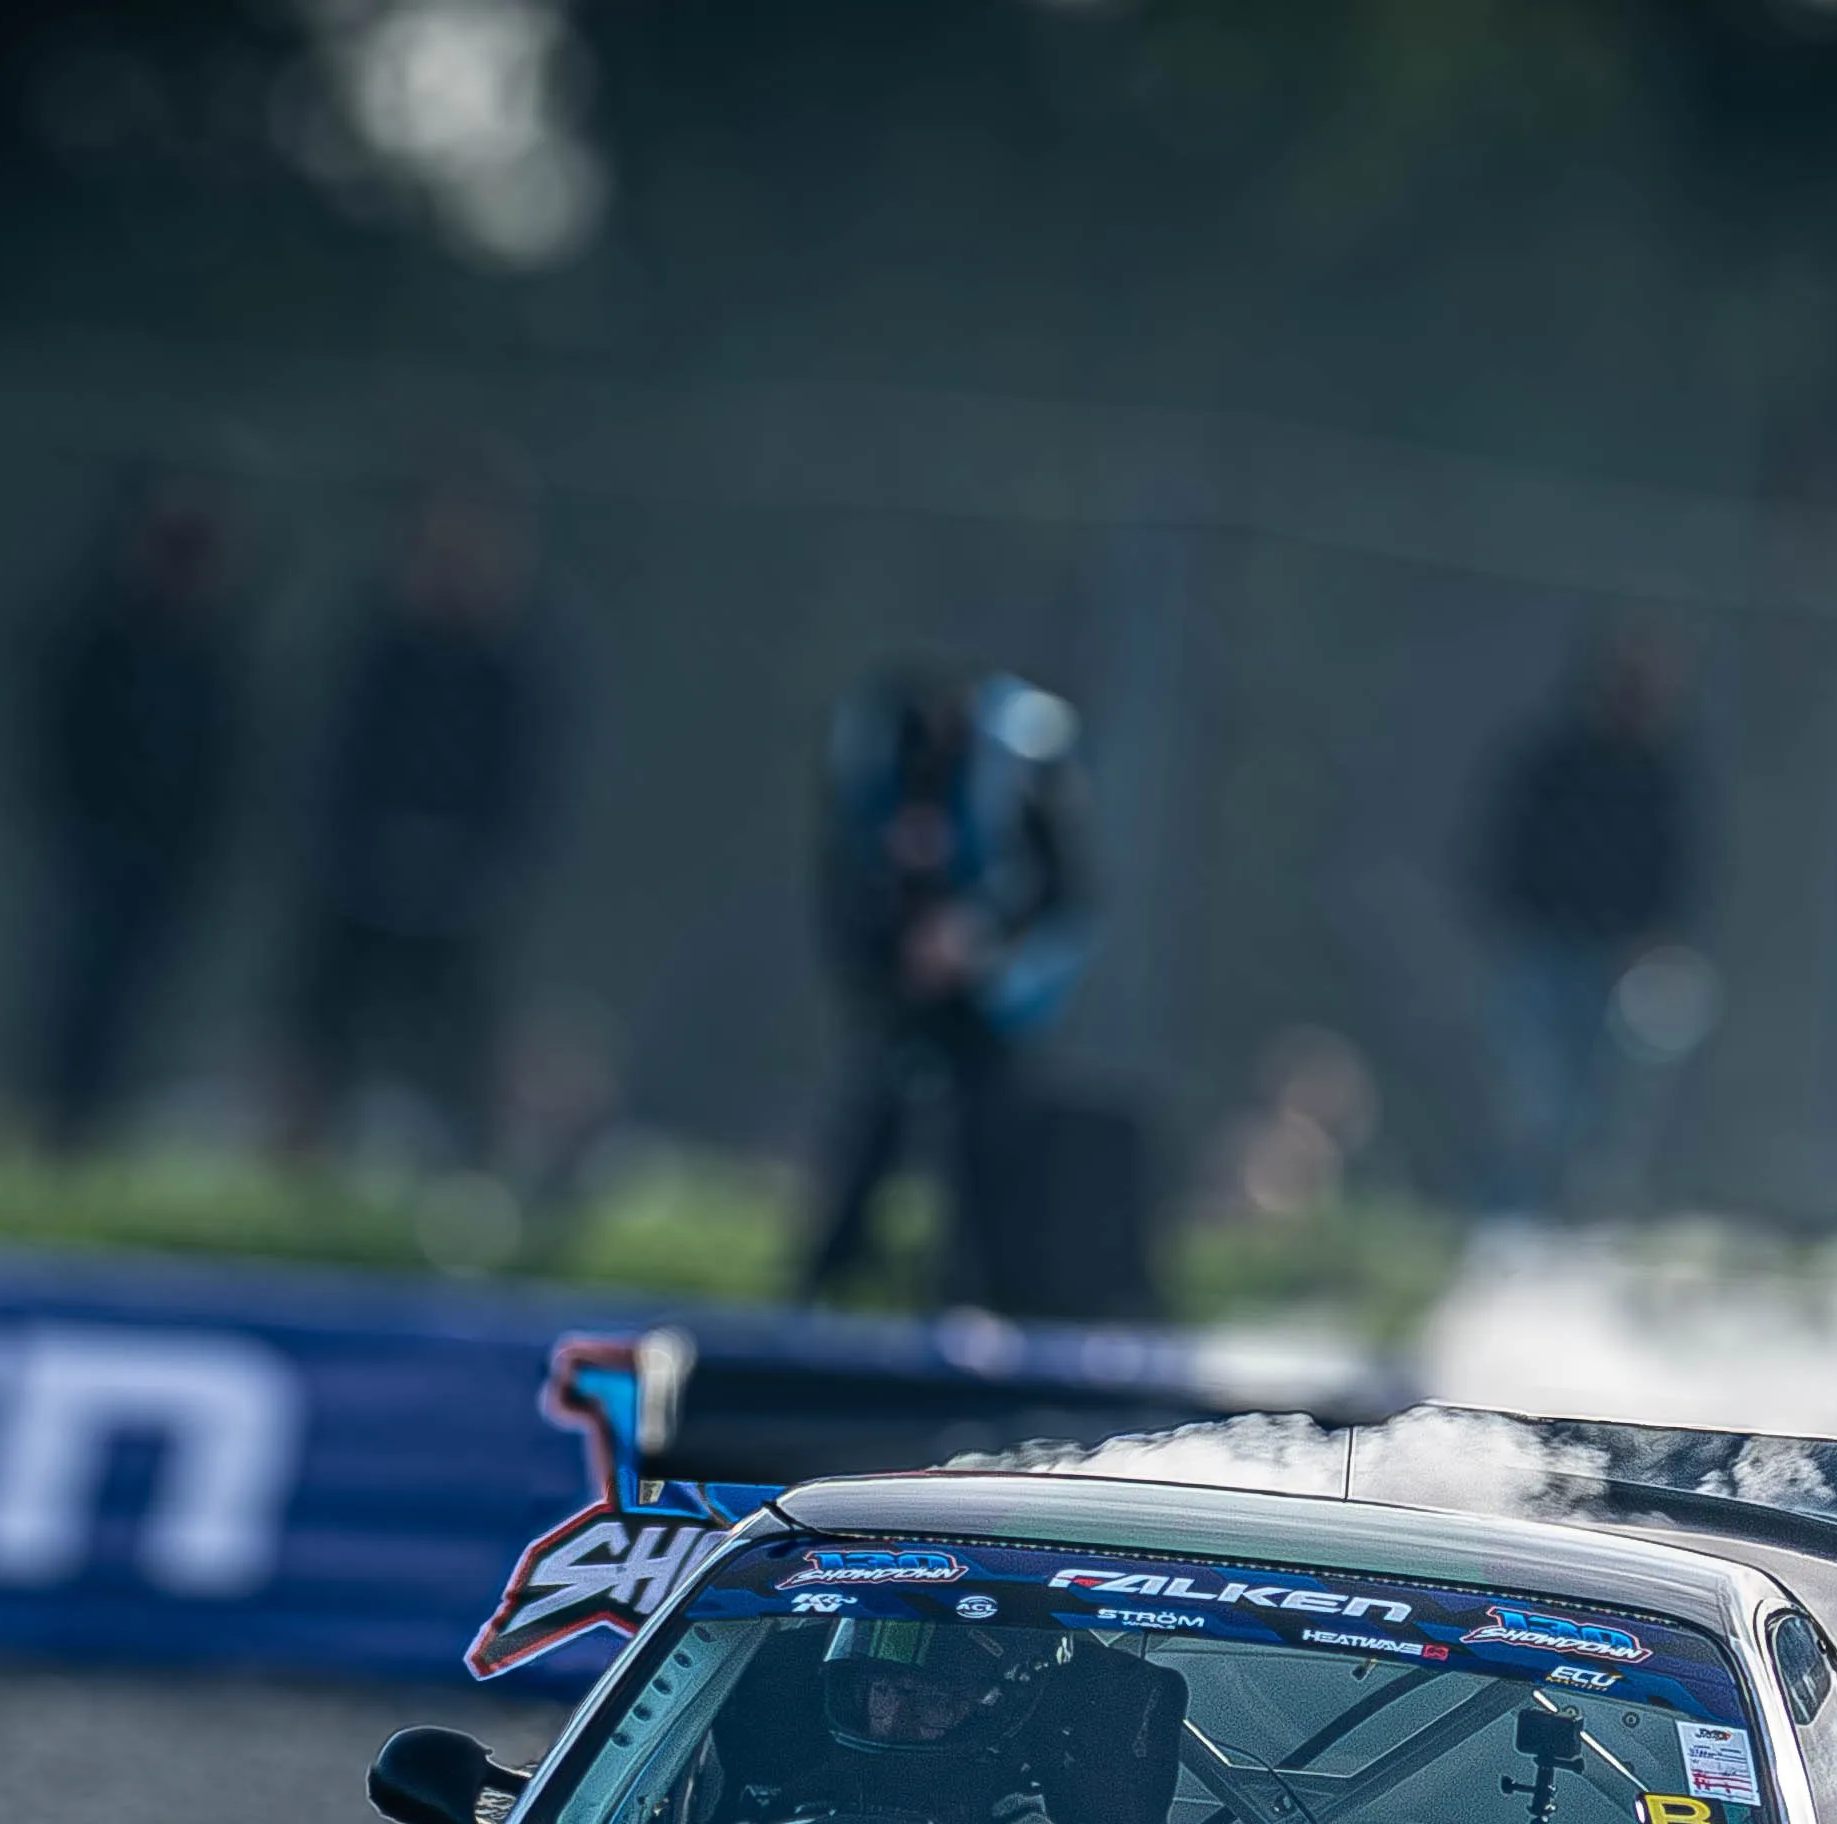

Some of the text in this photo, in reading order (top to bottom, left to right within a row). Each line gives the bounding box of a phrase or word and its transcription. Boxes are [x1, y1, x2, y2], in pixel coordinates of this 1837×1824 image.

[792, 1568, 959, 1584] SHOWDOWN
[1048, 1569, 1412, 1623] FALKEN
[1098, 1608, 1205, 1627] STRÖM
[1302, 1629, 1423, 1656] HEATWAVE
[1474, 1627, 1643, 1659] SHOWDOWN
[1551, 1666, 1623, 1687] ECU
